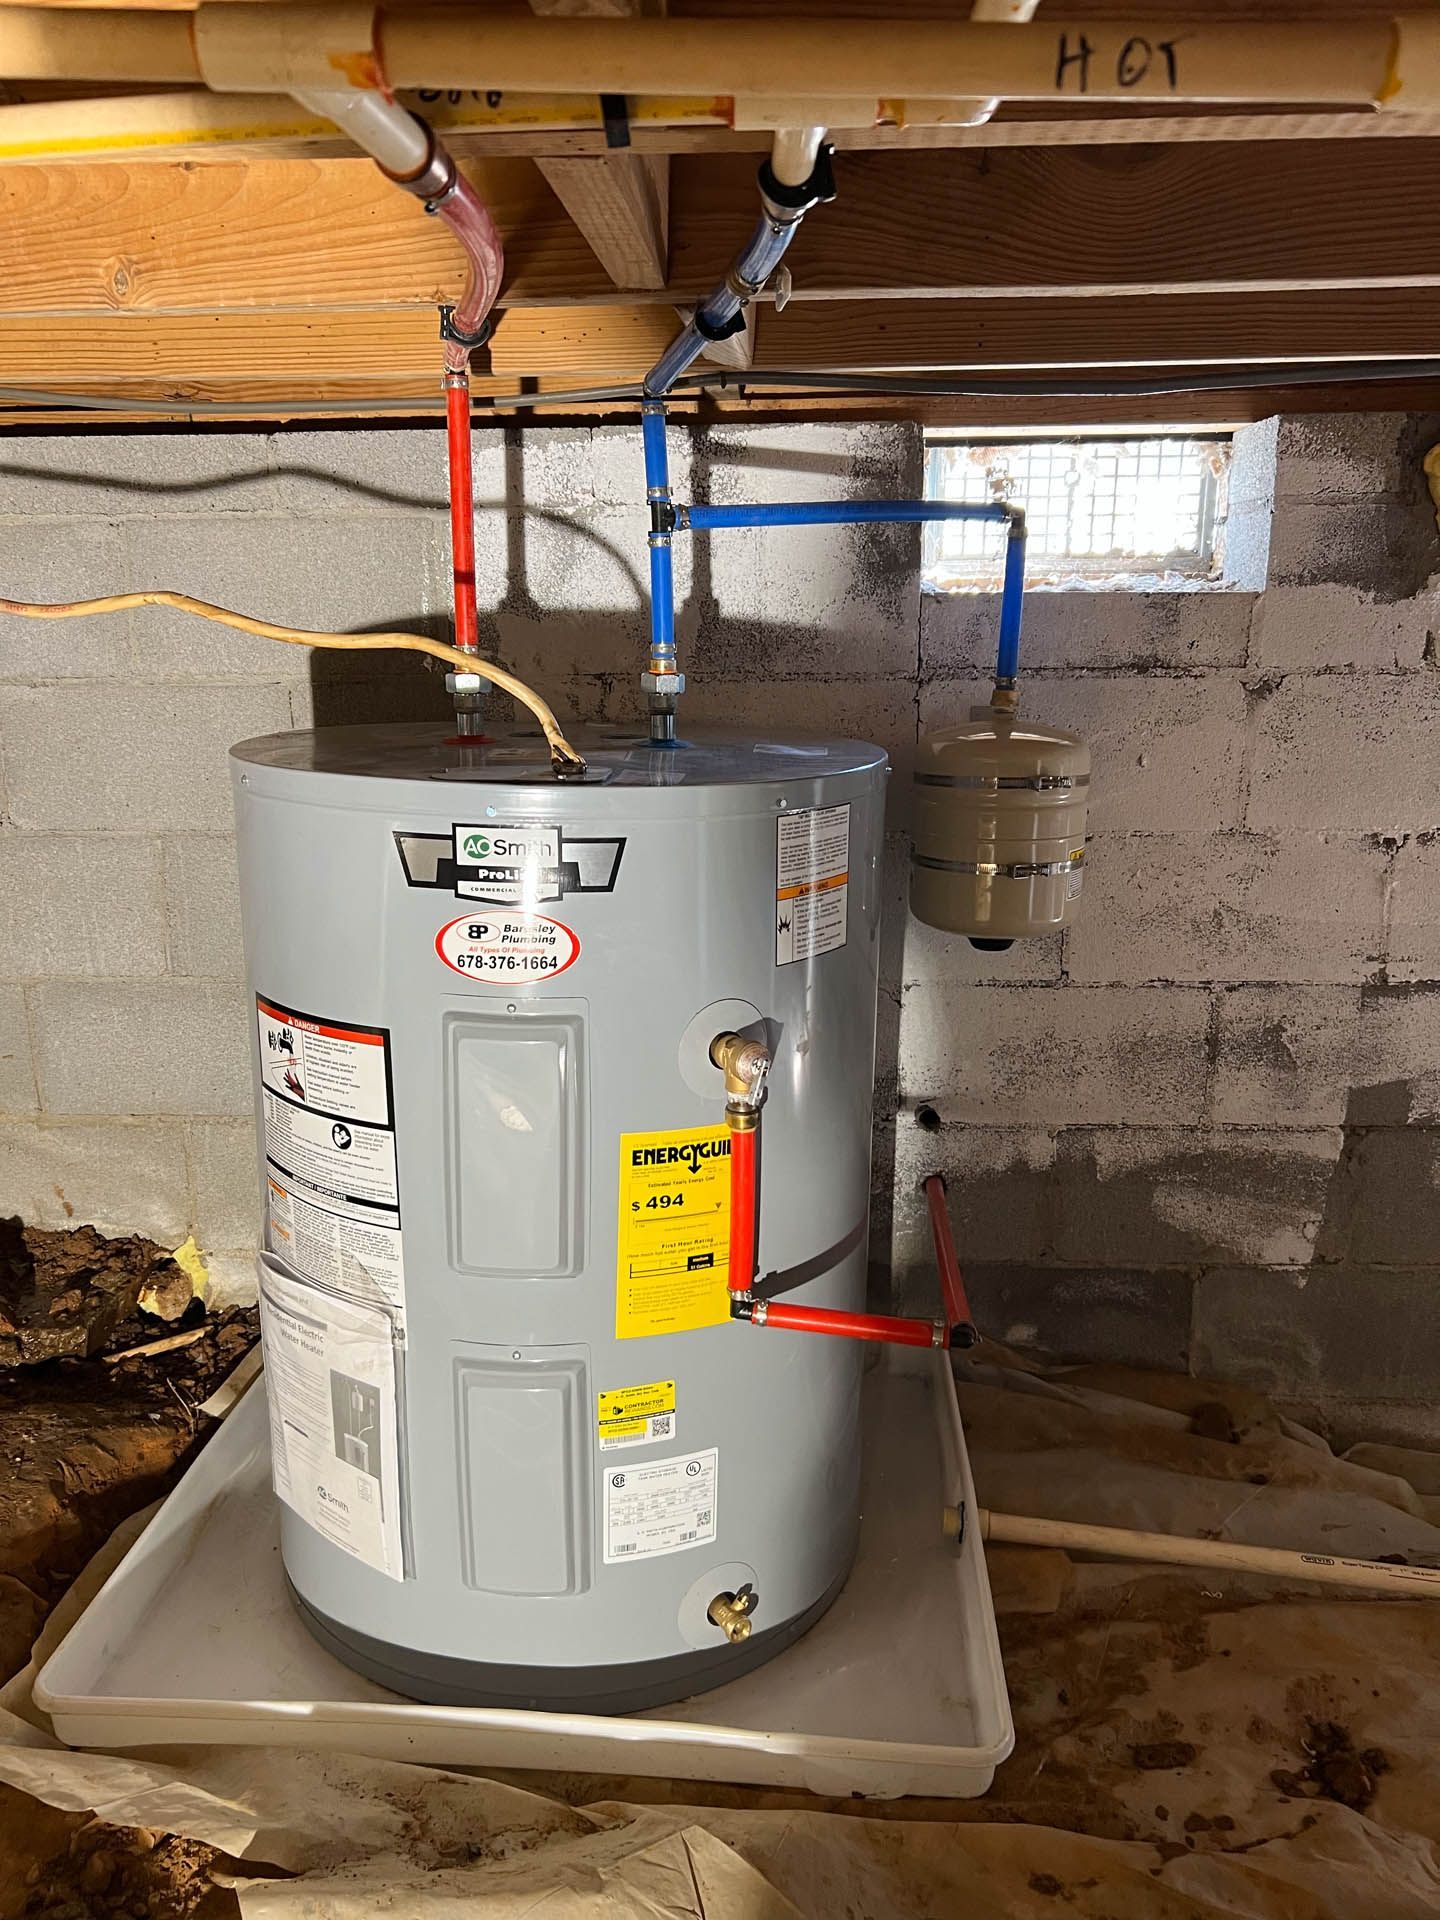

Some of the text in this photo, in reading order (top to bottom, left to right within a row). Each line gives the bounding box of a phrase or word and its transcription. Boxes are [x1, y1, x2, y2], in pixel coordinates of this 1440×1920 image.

[1056, 32, 1188, 93] HOT
[493, 839, 552, 856] Smh
[478, 868, 530, 881] ProLi
[501, 934, 556, 945] Plumbing
[479, 946, 500, 954] Types
[457, 954, 558, 970] 678-376-1664
[294, 1019, 321, 1034] DANGER
[631, 1139, 732, 1167] ENERGYGUI
[645, 1192, 684, 1209] 494
[694, 1237, 714, 1245] Rating
[298, 1324, 324, 1344] Electric
[281, 1329, 324, 1358] Water Heater
[624, 1398, 665, 1410] CONTRACTOR
